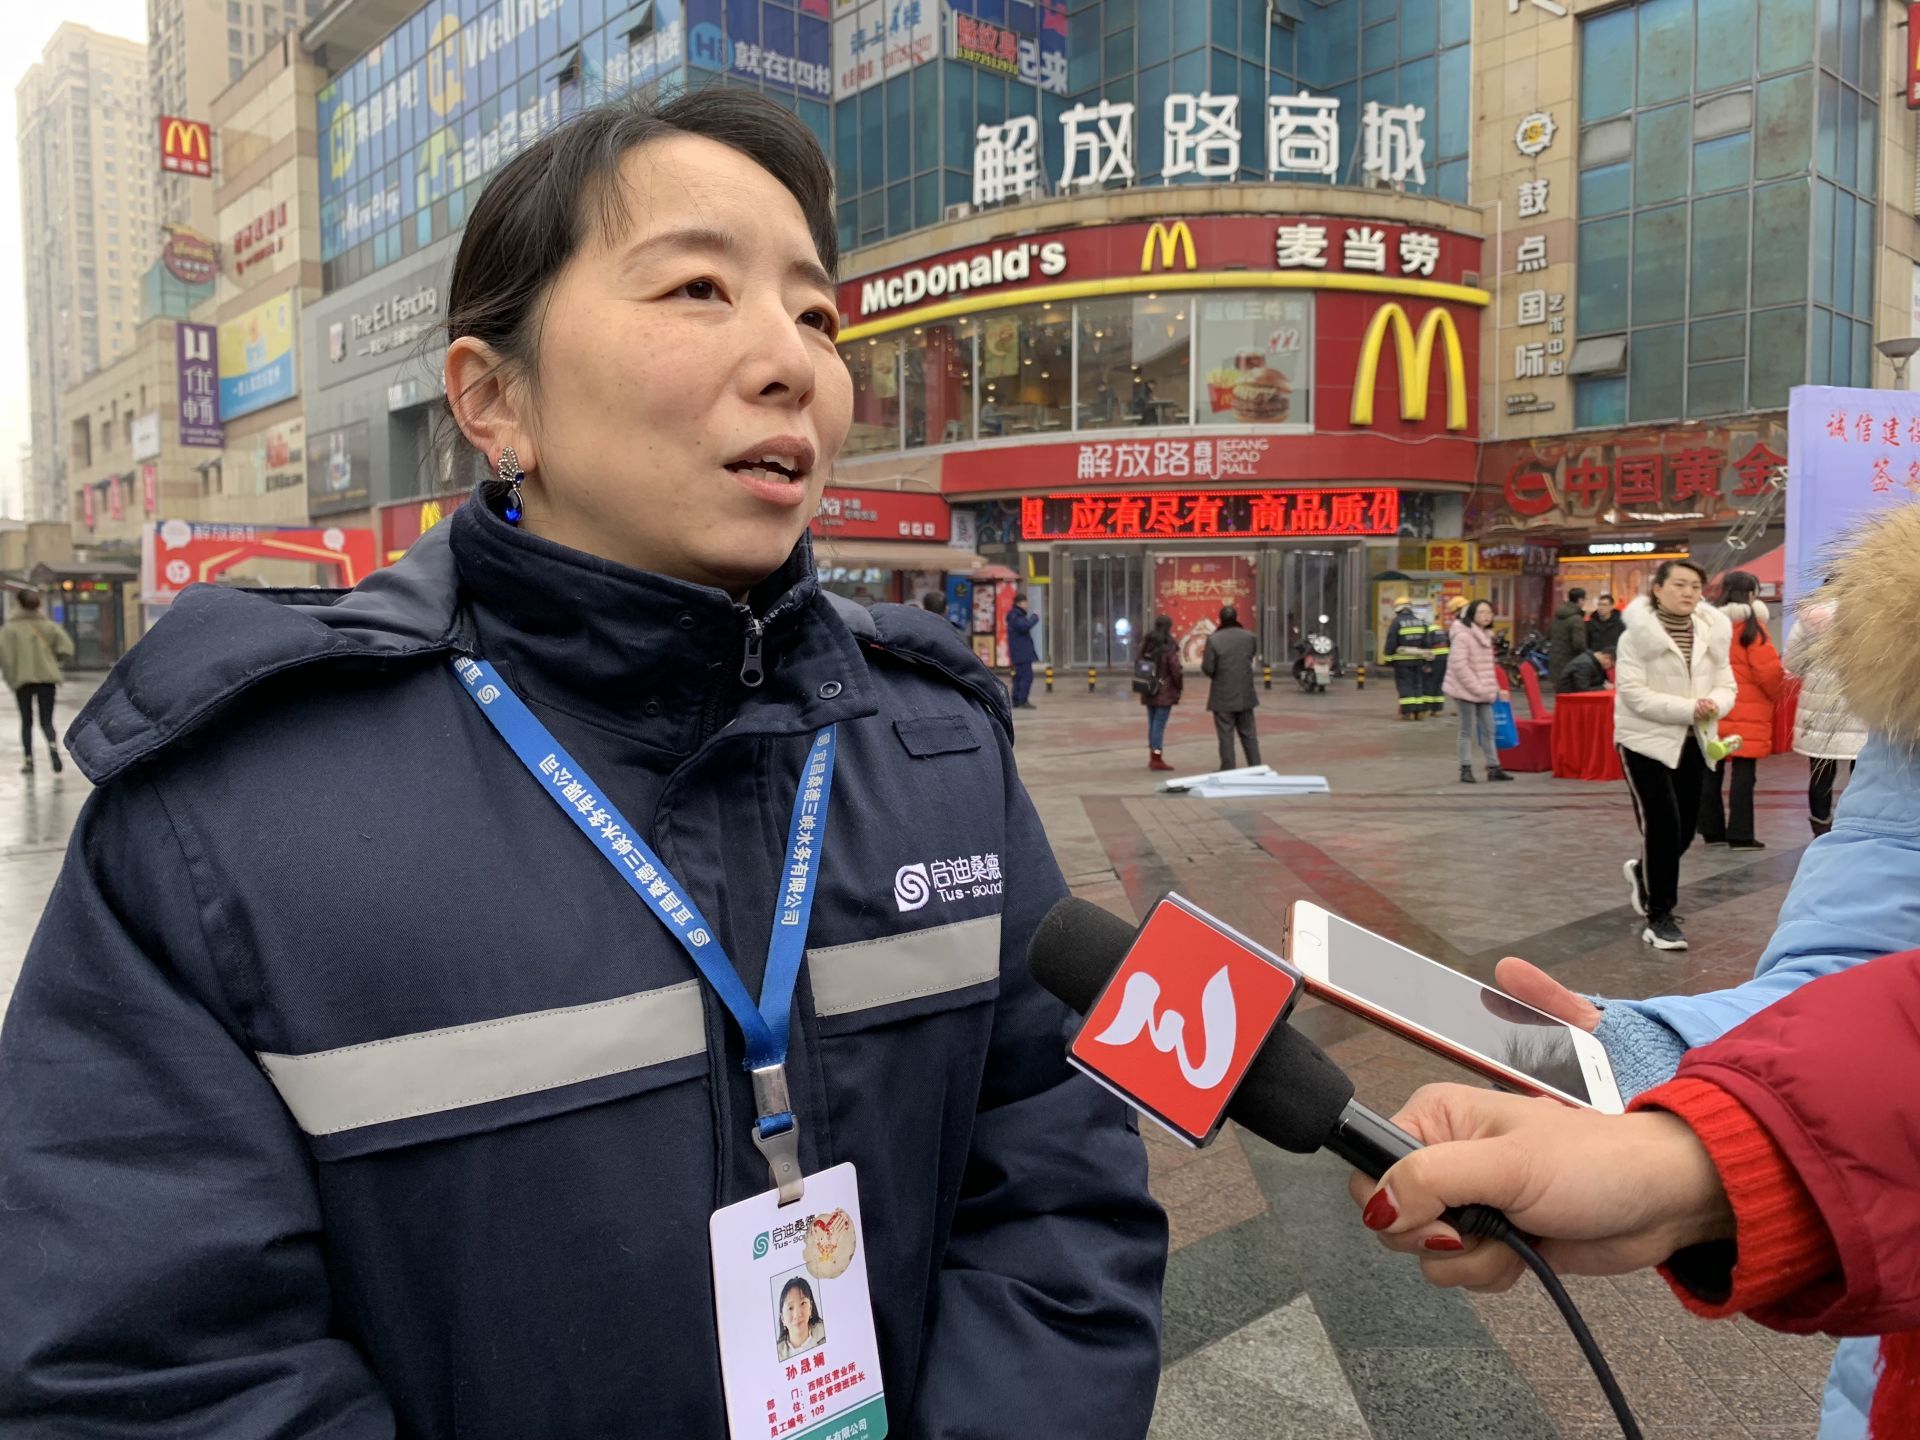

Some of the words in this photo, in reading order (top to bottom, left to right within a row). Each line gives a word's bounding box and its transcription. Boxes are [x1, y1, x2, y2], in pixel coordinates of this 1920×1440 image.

[973, 91, 1426, 205] 解放路商城
[1276, 223, 1440, 276] 麦当劳
[860, 242, 1067, 316] McDonald's
[1514, 178, 1549, 380] 鼓点国际
[1077, 442, 1189, 479] 解放路
[1219, 452, 1260, 464] ROAD
[1219, 463, 1256, 475] MALL
[1563, 442, 1788, 507] 中国黄金
[1069, 495, 1225, 537] 应有尽有
[930, 853, 1003, 889] 启迪桑德
[810, 1404, 826, 1418] 109
